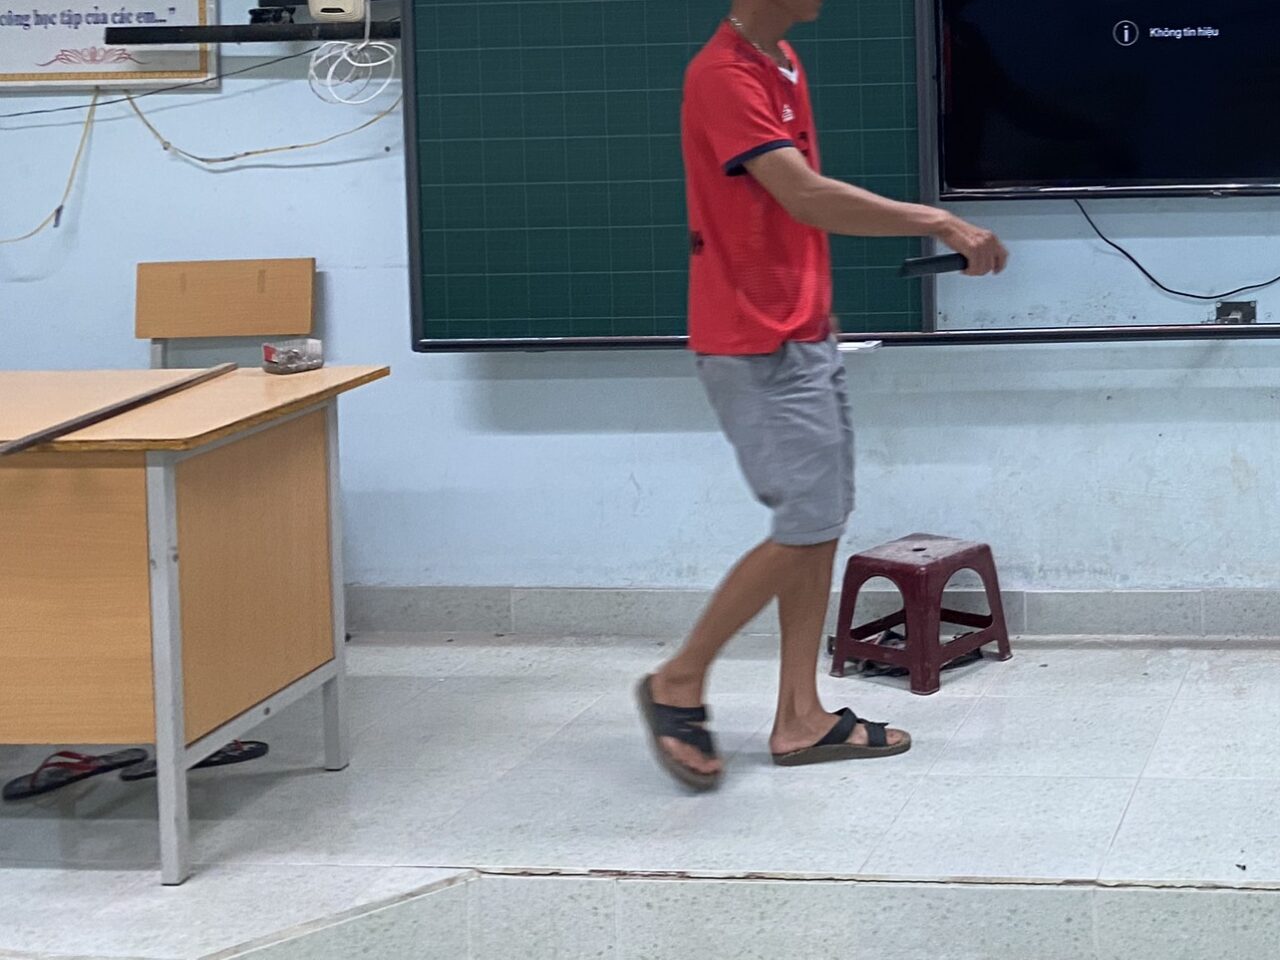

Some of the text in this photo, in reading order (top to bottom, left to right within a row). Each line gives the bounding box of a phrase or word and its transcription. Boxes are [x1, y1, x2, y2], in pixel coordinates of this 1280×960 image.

[111, 6, 133, 25] các
[1149, 26, 1219, 39] Không tín hiệu
